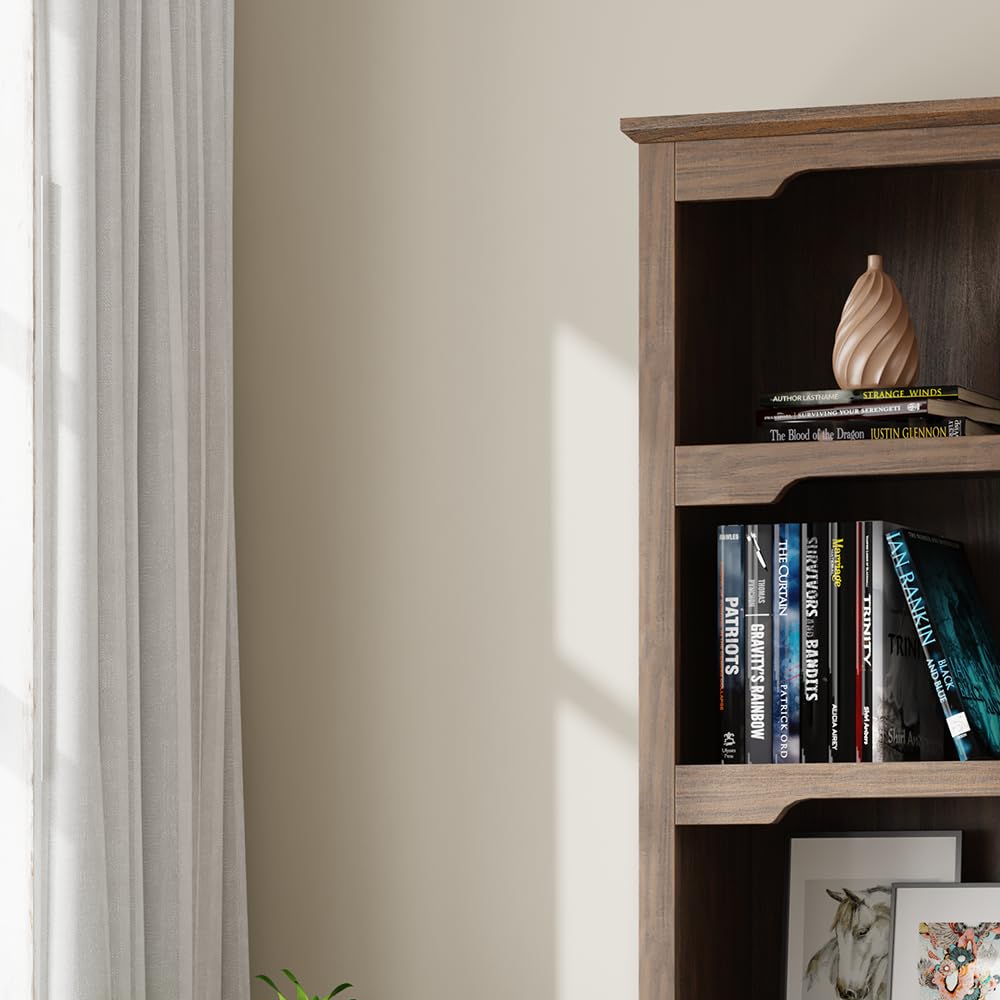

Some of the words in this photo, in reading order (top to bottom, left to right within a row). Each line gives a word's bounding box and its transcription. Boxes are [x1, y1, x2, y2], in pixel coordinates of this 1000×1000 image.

[862, 390, 905, 399] STRANGE
[909, 388, 942, 397] WINDS
[770, 429, 786, 441] The
[788, 428, 810, 440] Blood
[812, 428, 821, 440] of
[822, 428, 834, 440] the
[837, 427, 864, 440] Dragon
[870, 427, 900, 440] JUSTIN
[902, 426, 947, 439] GLENNON
[778, 539, 788, 563] THE
[831, 538, 844, 588] Marriage
[758, 578, 766, 604] THOMAS
[778, 564, 789, 617] CURTAIN
[805, 536, 818, 618] SURVIVORS
[886, 532, 910, 568] IAN
[899, 574, 936, 647] RANKIN
[724, 596, 739, 676] PATRIOTS
[863, 593, 872, 668] TRINITY
[805, 640, 818, 702] BANDITS
[926, 658, 938, 681] AND
[934, 681, 948, 704] BLUE
[937, 658, 955, 691] BLACK
[750, 686, 764, 740] RAINBOW
[780, 684, 788, 729] PATRICK
[780, 736, 788, 759] ORD
